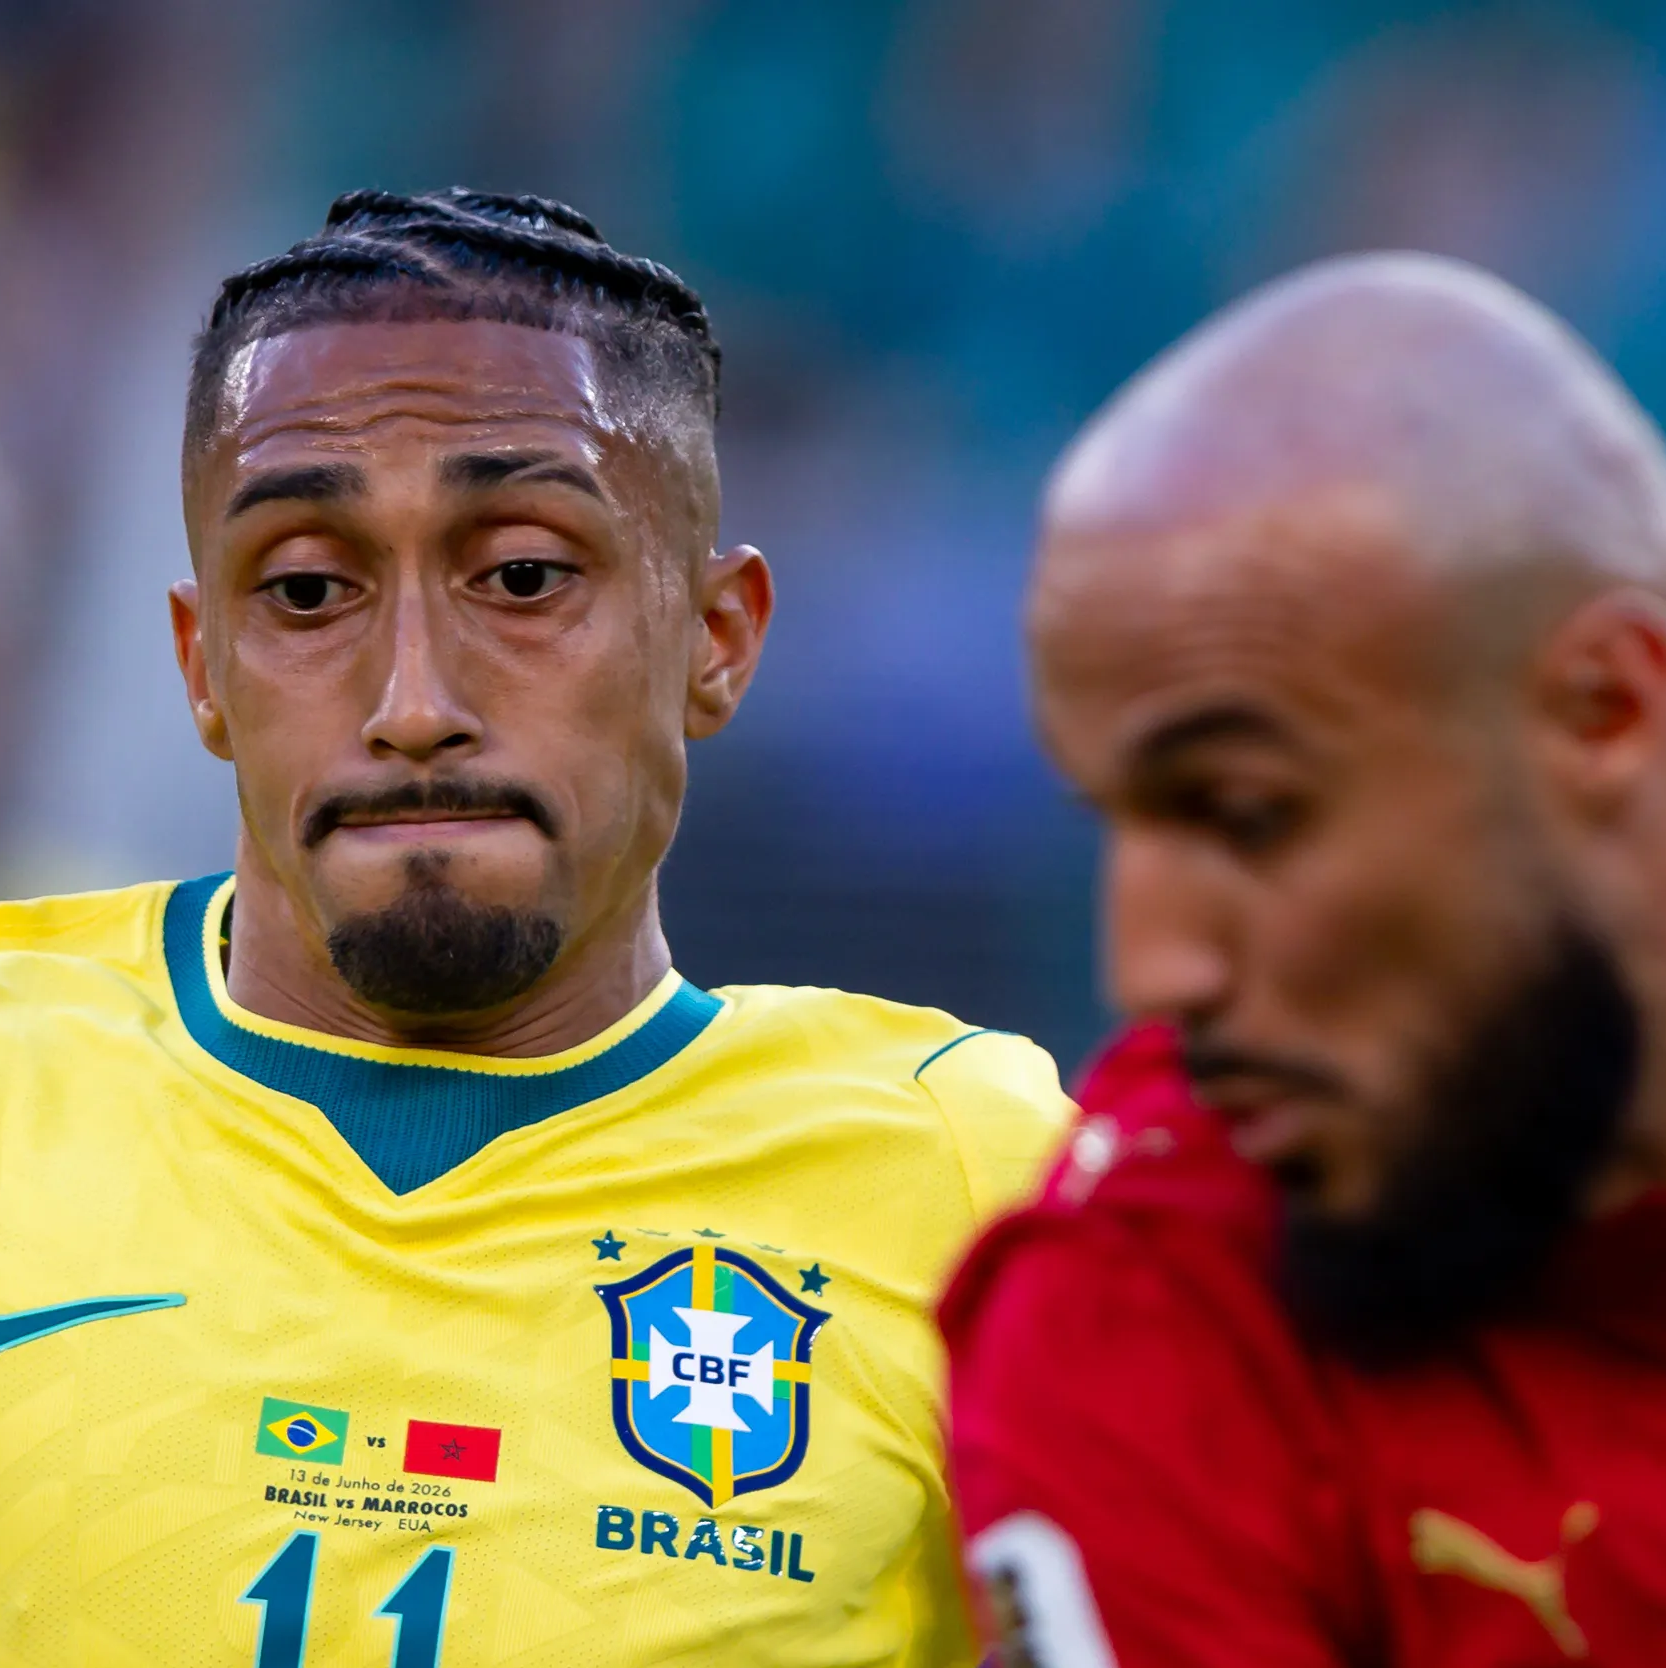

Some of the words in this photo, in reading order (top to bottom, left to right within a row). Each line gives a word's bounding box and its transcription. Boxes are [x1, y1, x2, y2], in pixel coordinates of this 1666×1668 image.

[671, 1351, 751, 1388] CBF
[366, 1436, 387, 1448] vs
[290, 1468, 307, 1483] 13
[312, 1471, 331, 1486] de
[336, 1475, 381, 1491] Junho
[386, 1478, 405, 1493] de
[411, 1482, 452, 1498] 2026
[264, 1485, 328, 1508] BRASIL
[335, 1498, 355, 1509] vs
[361, 1496, 469, 1518] MARROCOS
[293, 1510, 330, 1523] New
[333, 1513, 383, 1532] Jersey
[594, 1505, 816, 1584] BRASIL
